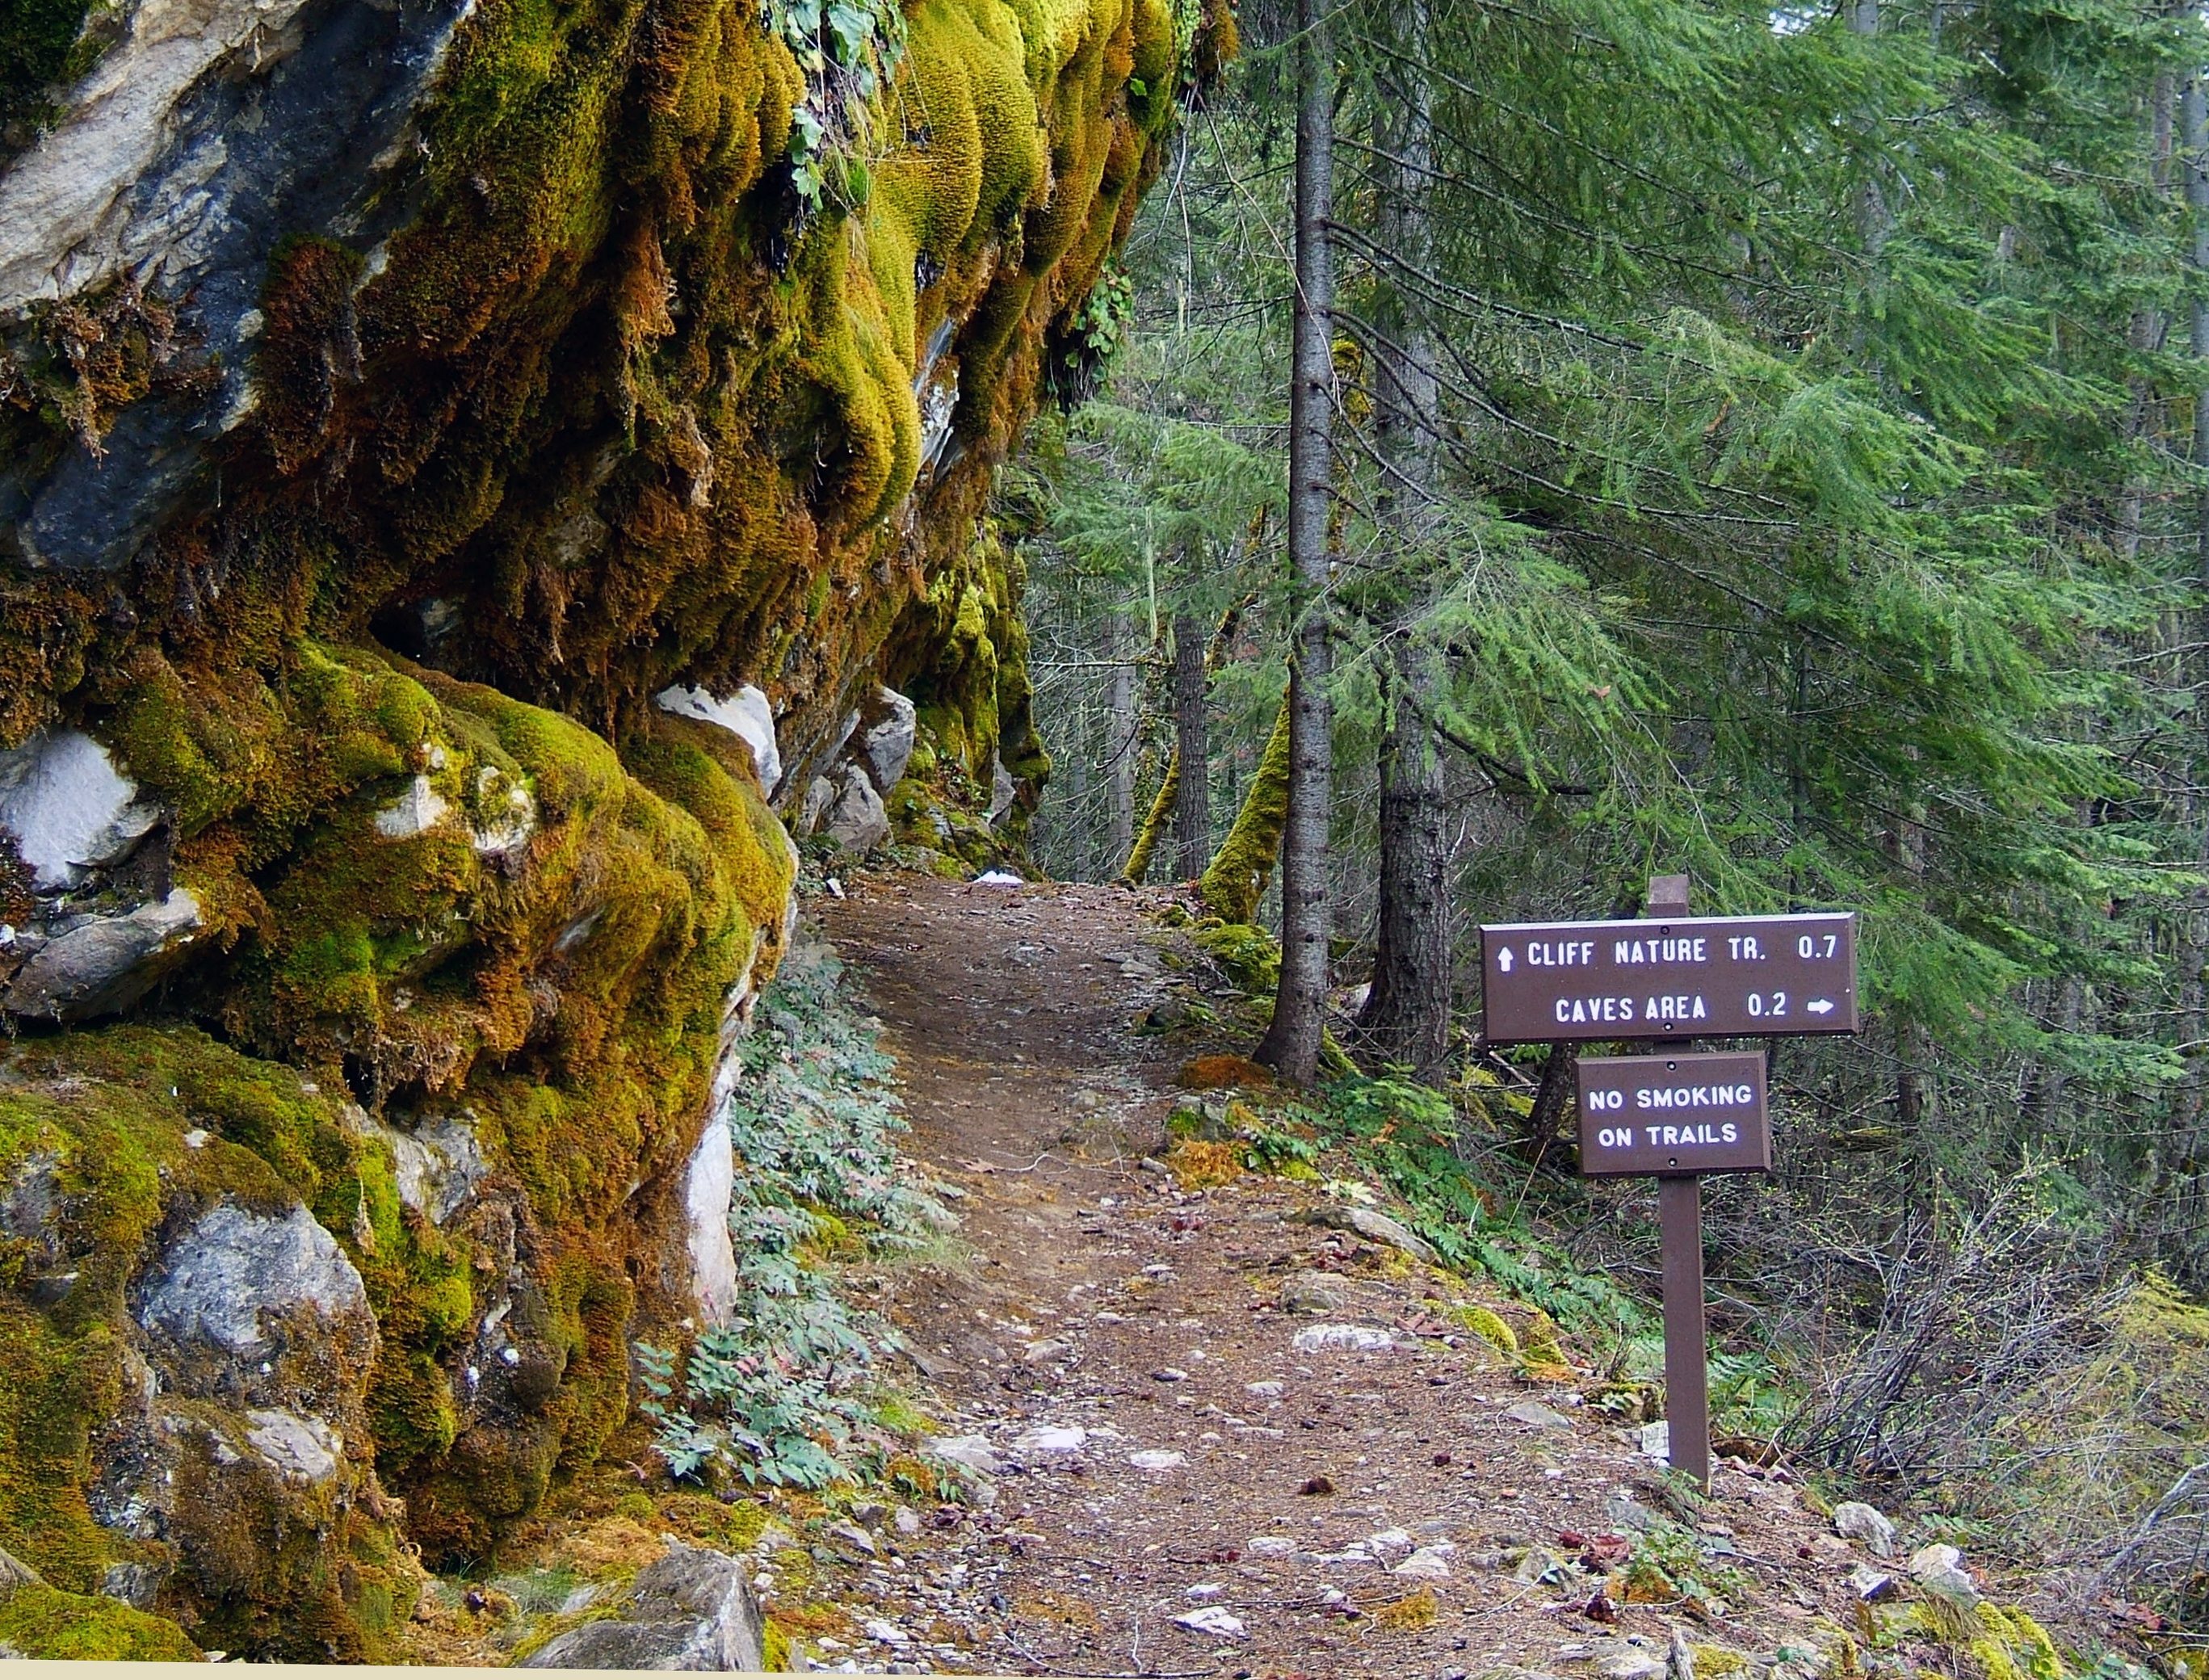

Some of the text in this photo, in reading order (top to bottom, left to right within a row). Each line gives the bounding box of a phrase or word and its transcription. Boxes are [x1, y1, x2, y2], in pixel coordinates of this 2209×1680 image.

[1527, 934, 1837, 966] CLIFF NATURE TR. 0.7
[1556, 992, 1786, 1023] CAVES AREA 0.2
[1589, 1085, 1752, 1111] NO SMOKING
[1598, 1123, 1737, 1147] ON TRAILS
